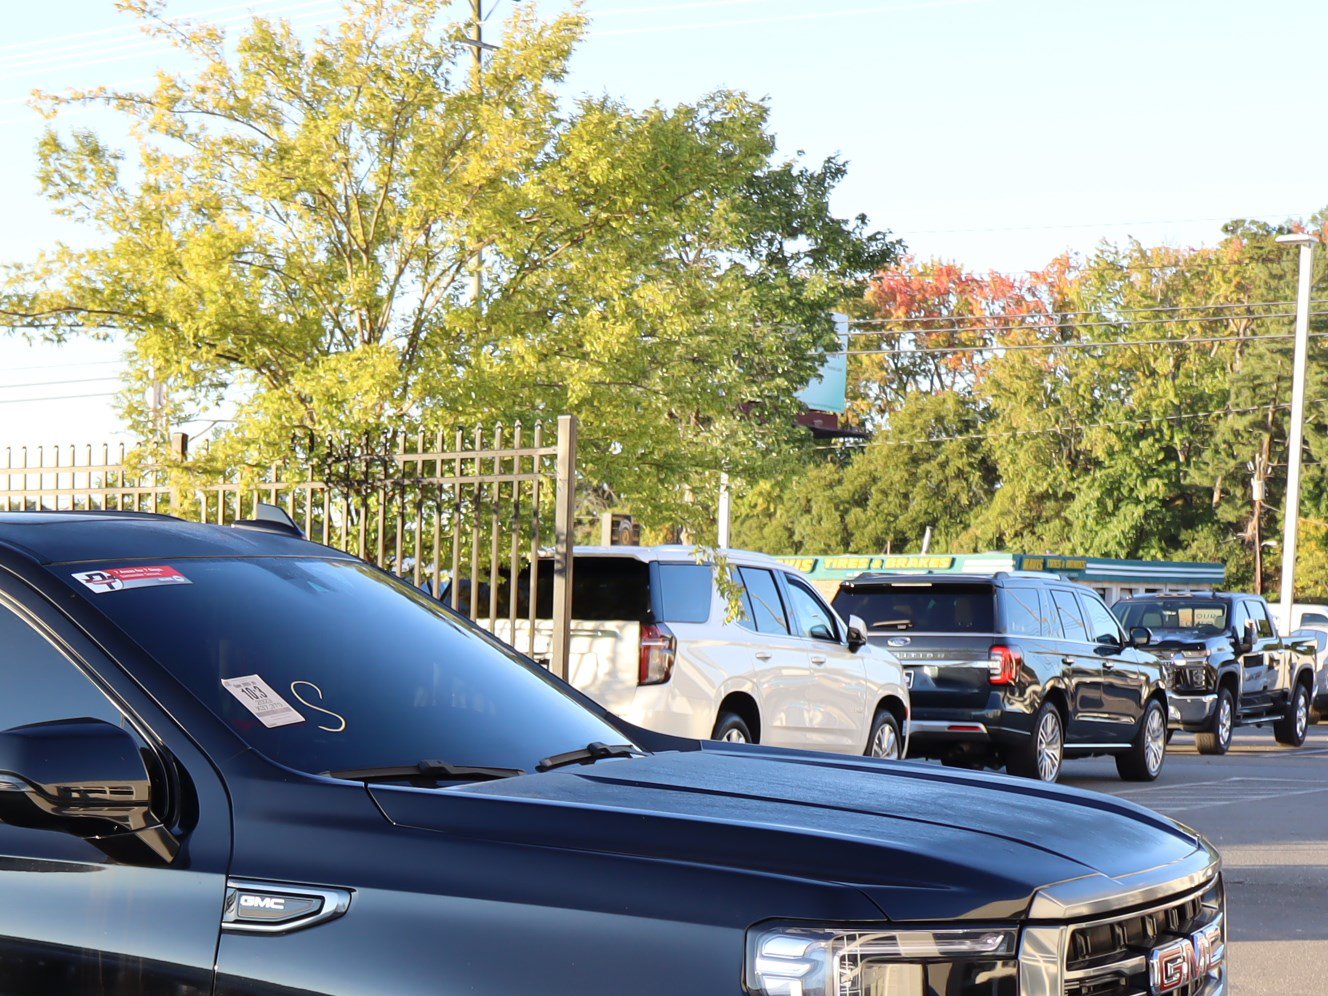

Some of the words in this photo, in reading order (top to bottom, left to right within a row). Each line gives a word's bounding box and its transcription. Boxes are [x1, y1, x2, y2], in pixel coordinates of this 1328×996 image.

[776, 558, 814, 573] VIS
[825, 557, 870, 569] TIRES
[871, 558, 882, 569] &
[885, 557, 952, 569] BRAKES
[290, 680, 346, 732] S
[240, 895, 285, 910] GMC
[1149, 922, 1224, 996] GMC
